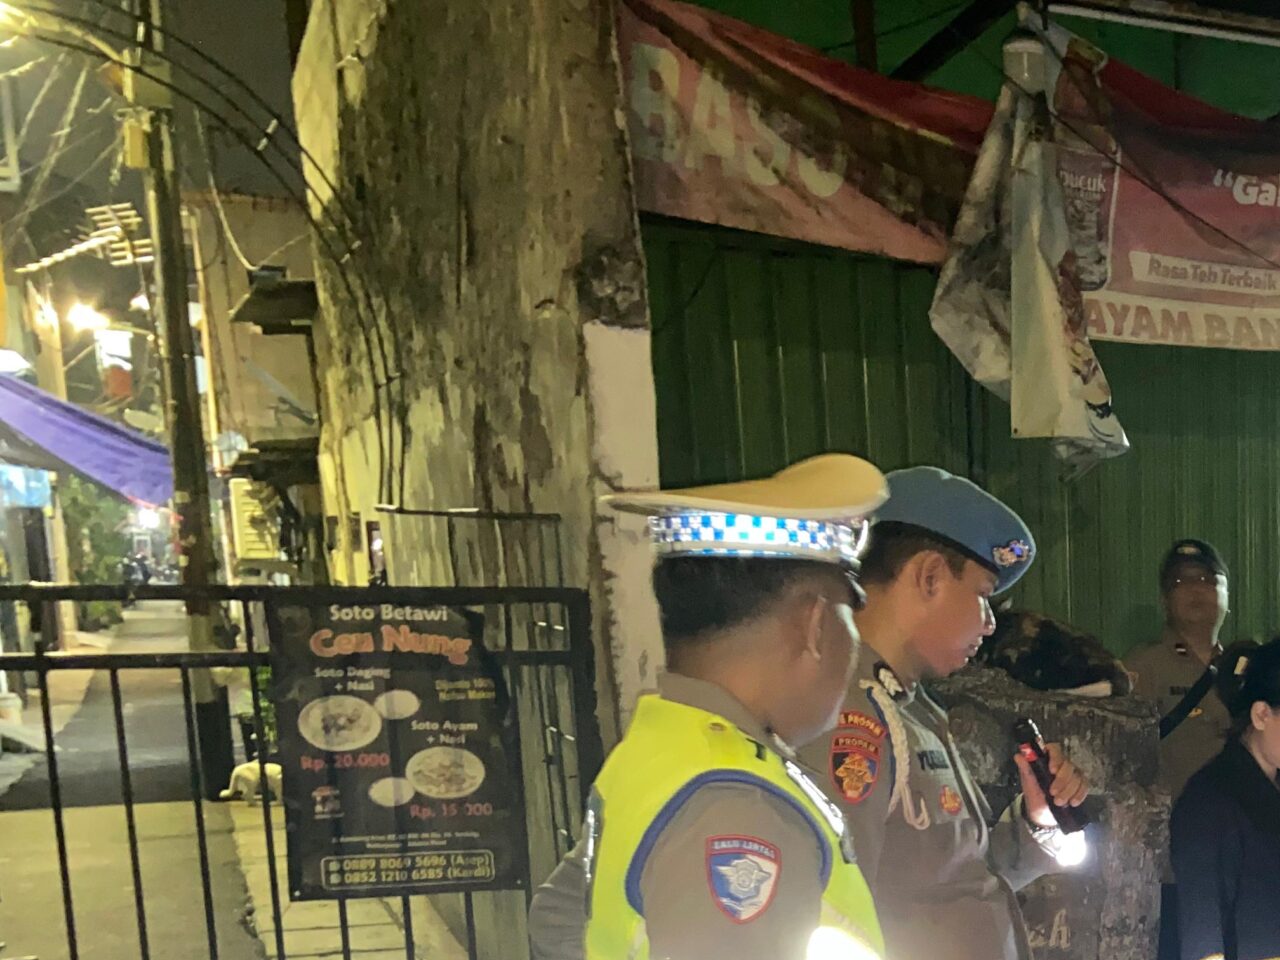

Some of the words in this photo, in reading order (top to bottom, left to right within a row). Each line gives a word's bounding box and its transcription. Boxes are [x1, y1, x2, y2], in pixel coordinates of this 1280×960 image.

[632, 41, 846, 197] BASO
[1148, 257, 1189, 280] Rasa
[1192, 263, 1218, 284] Teh
[1220, 267, 1276, 291] Terbaik
[1086, 299, 1195, 343] AYAM
[330, 604, 375, 621] Soto
[380, 603, 449, 622] Betawi
[380, 624, 472, 665] Nung
[315, 667, 344, 678] Soto
[346, 680, 375, 692] Nasi
[411, 720, 439, 732] Soto
[442, 720, 479, 734] Ayam
[439, 732, 466, 745] Nasi
[838, 737, 876, 752] PROPAM
[334, 753, 391, 769] 20.000
[410, 804, 437, 821] Rp.
[381, 870, 408, 882] 1210
